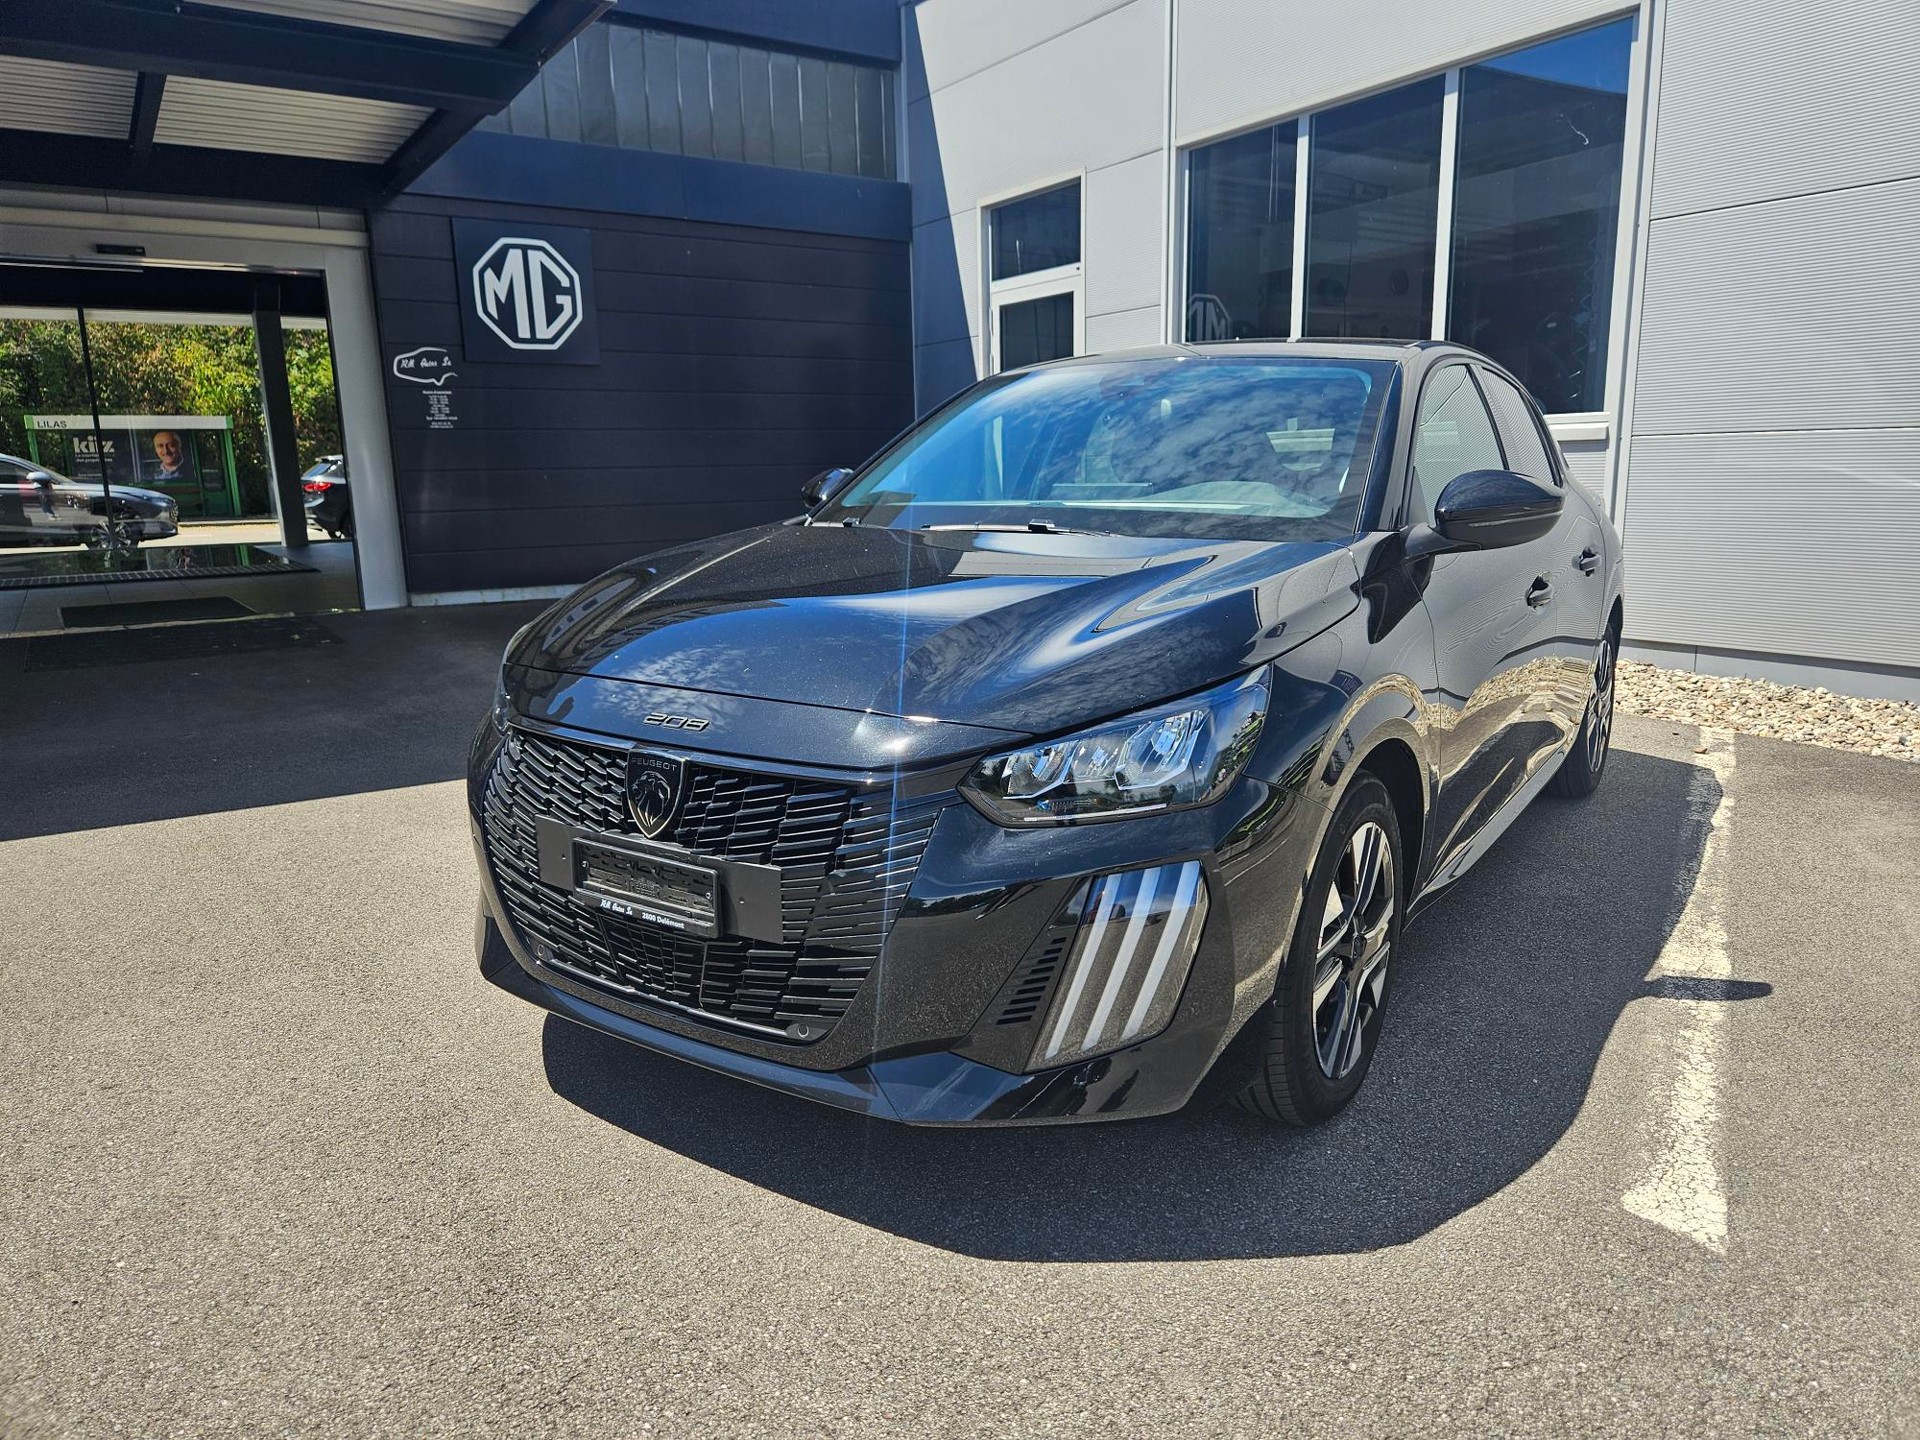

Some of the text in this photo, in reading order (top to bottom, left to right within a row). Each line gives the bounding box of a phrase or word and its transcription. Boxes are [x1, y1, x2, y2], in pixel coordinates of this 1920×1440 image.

[484, 248, 573, 340] MG
[37, 420, 67, 429] LILAS
[643, 712, 710, 732] 208
[631, 757, 678, 771] PEUGEOT
